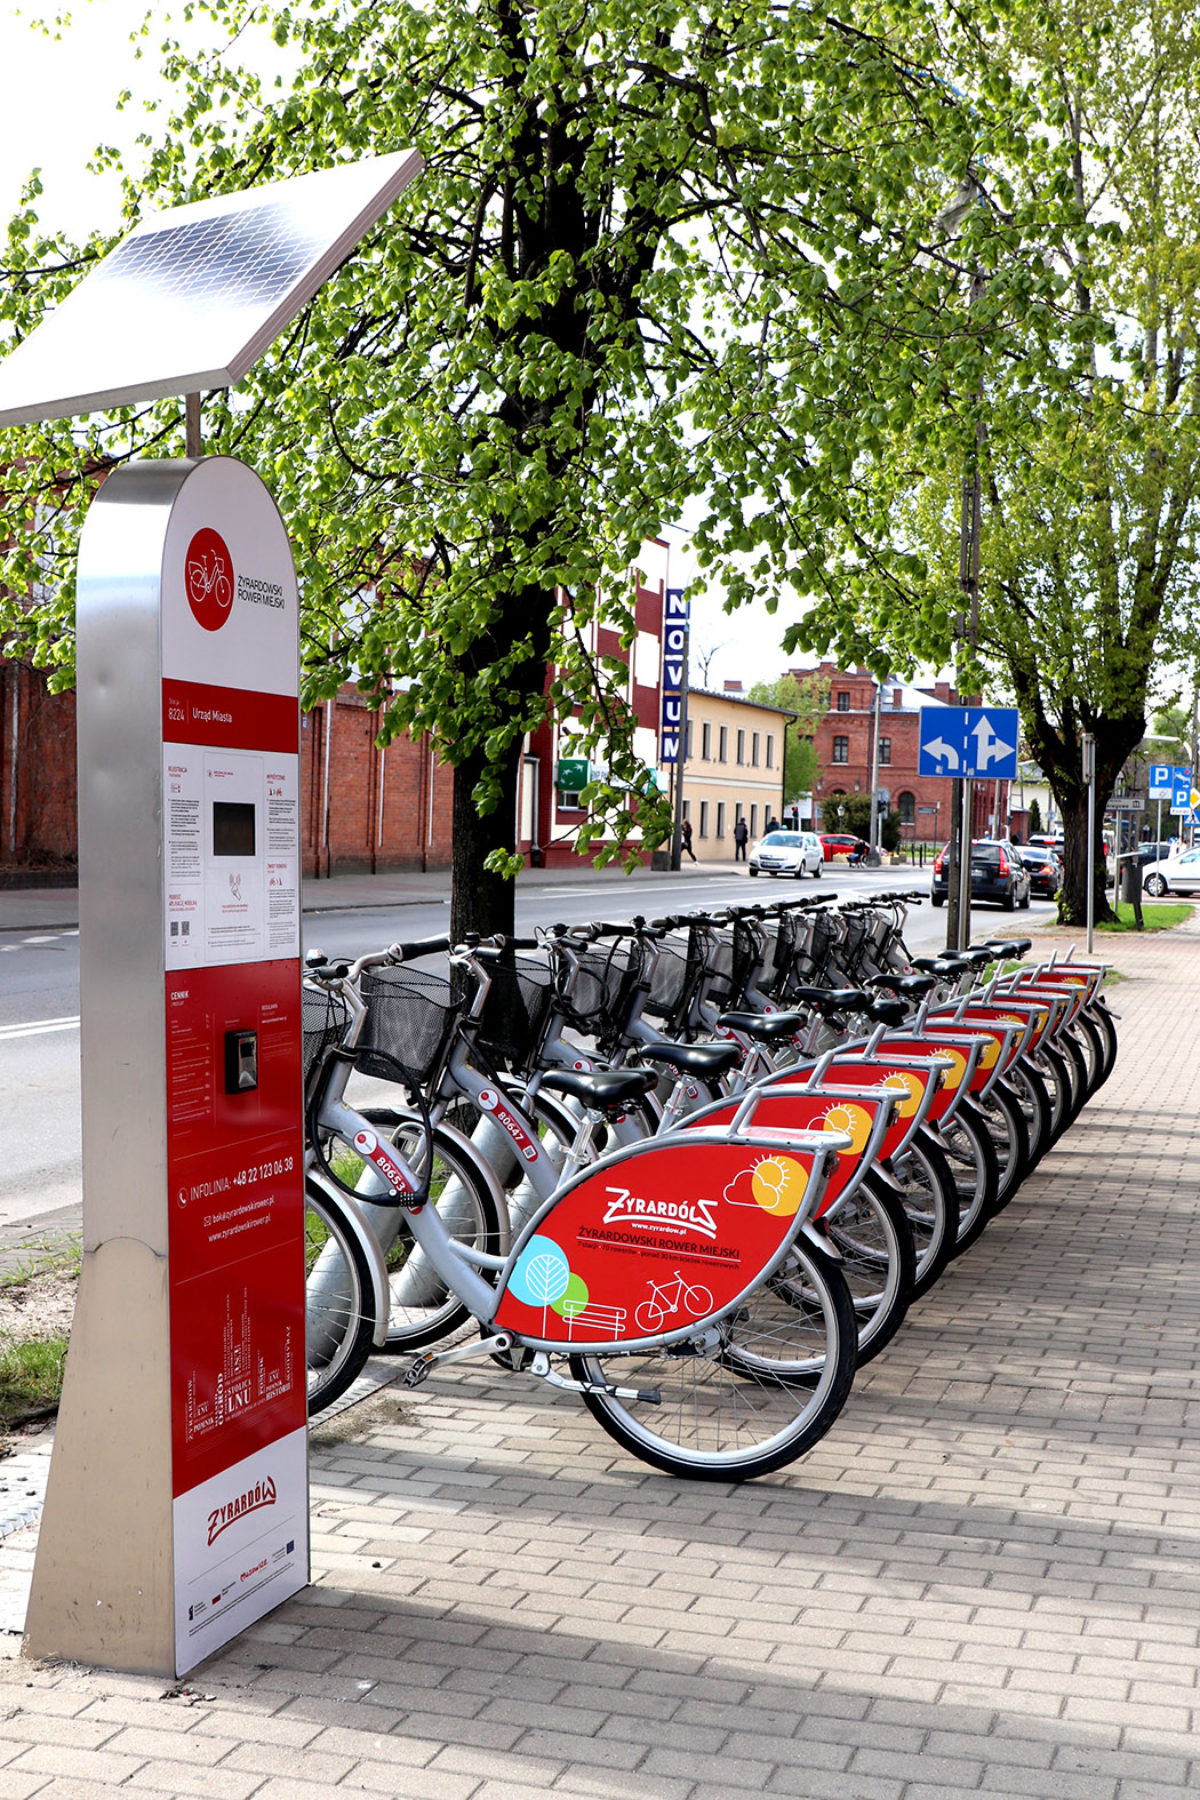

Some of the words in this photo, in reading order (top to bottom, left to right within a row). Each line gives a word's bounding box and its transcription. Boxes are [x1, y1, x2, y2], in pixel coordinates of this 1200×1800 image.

[238, 588, 262, 604] ROWER
[262, 594, 285, 609] MIEJSKI
[664, 594, 686, 758] NOVUM
[168, 707, 185, 721] 8224
[192, 706, 211, 723] Urząd
[212, 709, 233, 723] Miasta
[1155, 767, 1168, 785] P
[1176, 791, 1187, 805] P
[497, 1111, 524, 1140] 80647
[190, 1177, 232, 1201] INFOLINIA:
[233, 1170, 247, 1187] +48
[247, 1167, 258, 1183] 22
[259, 1161, 273, 1180] 123
[273, 1159, 283, 1176] 06
[284, 1156, 294, 1172] 38
[376, 1156, 406, 1191] 80653
[631, 1222, 687, 1236] www.zyrardow.pl
[578, 1226, 658, 1247] ŻYRARDOWSKI
[659, 1238, 698, 1254] ROWER
[699, 1244, 740, 1259] MIEJSKI
[228, 1387, 251, 1413] LNU
